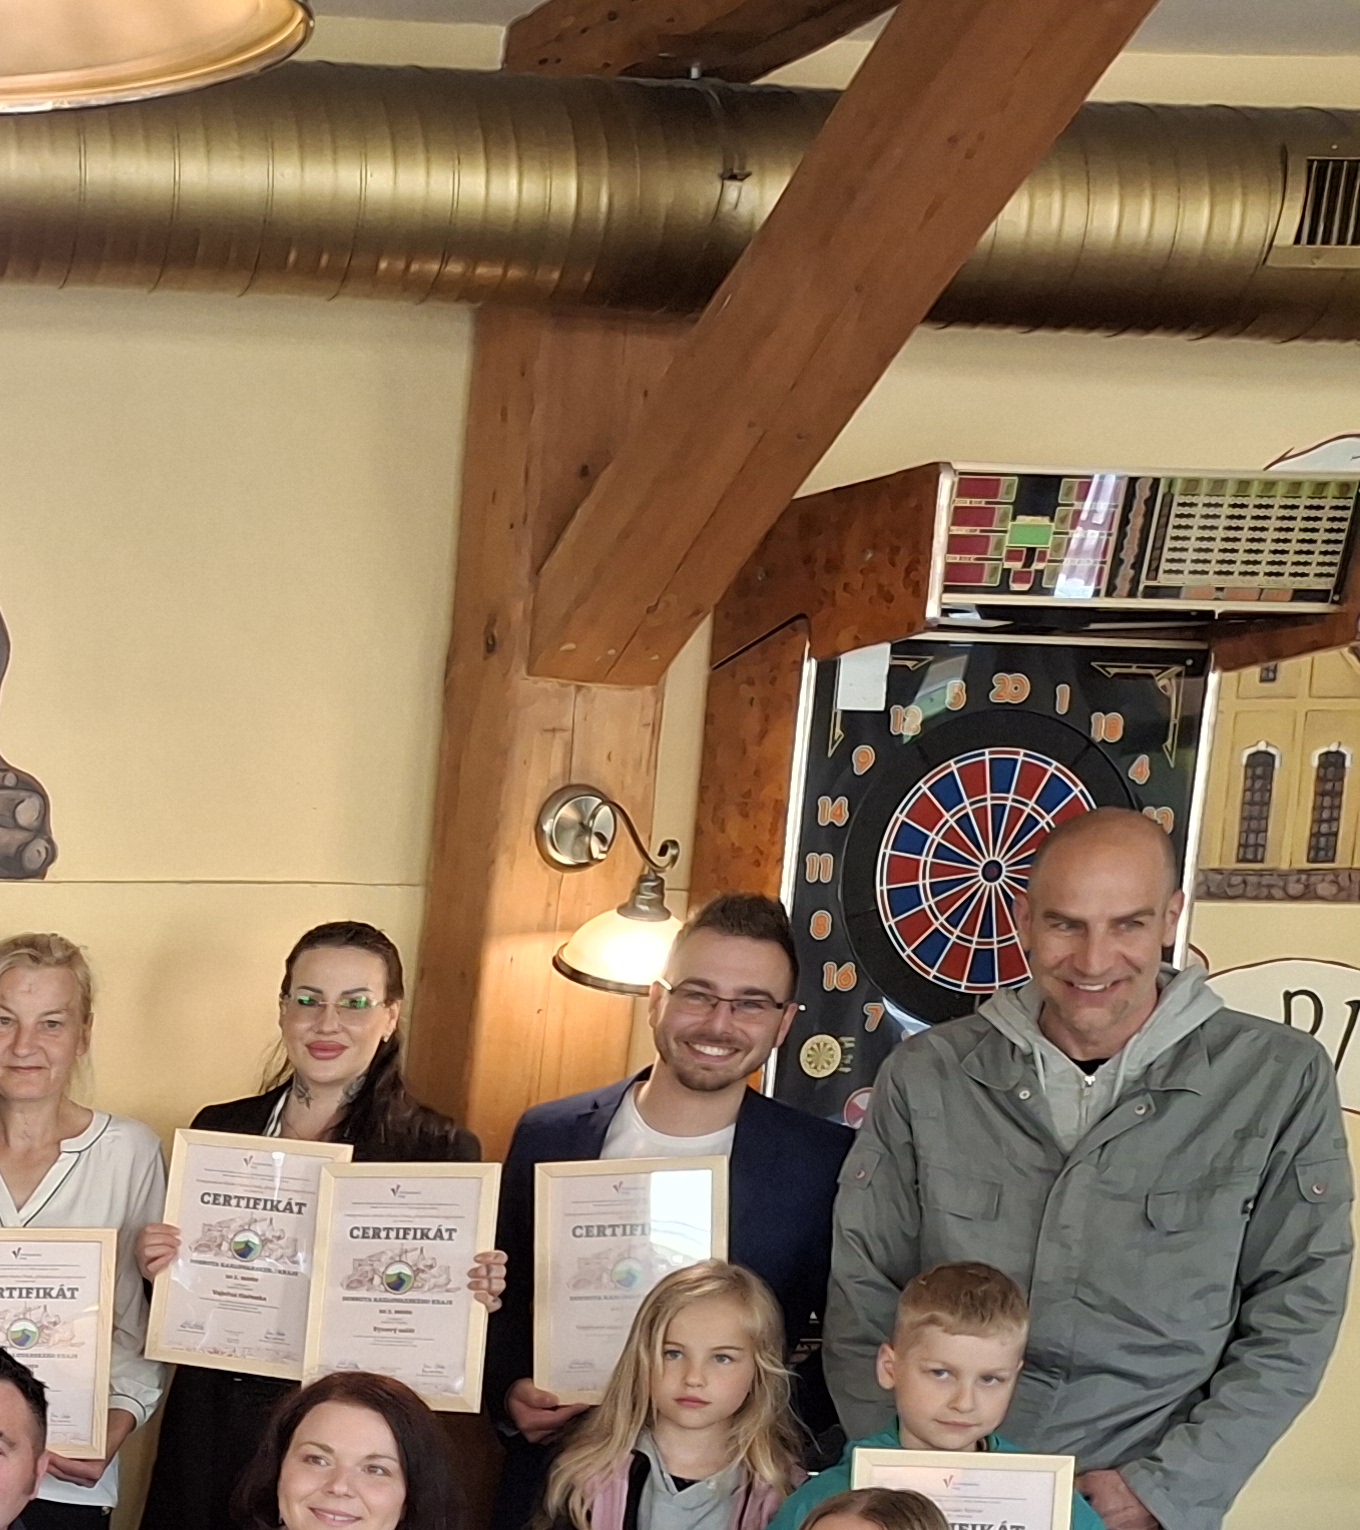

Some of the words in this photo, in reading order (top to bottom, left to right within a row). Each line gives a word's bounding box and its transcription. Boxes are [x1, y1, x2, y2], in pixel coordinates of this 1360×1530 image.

[945, 680, 966, 710] 5
[989, 673, 1030, 703] 20
[1056, 684, 1070, 714] 1
[890, 705, 922, 736] 12
[1091, 712, 1124, 742] 18
[852, 745, 875, 775] 9
[1128, 755, 1150, 784] 4
[818, 796, 849, 826] 14
[806, 853, 833, 883] 11
[810, 910, 832, 940] 8
[823, 962, 857, 991] 16
[864, 1003, 884, 1032] 7
[200, 1192, 307, 1215] CERTIFIKÁT
[350, 1225, 457, 1241] CERTIFIKÁT
[572, 1224, 649, 1238] CERTIFI
